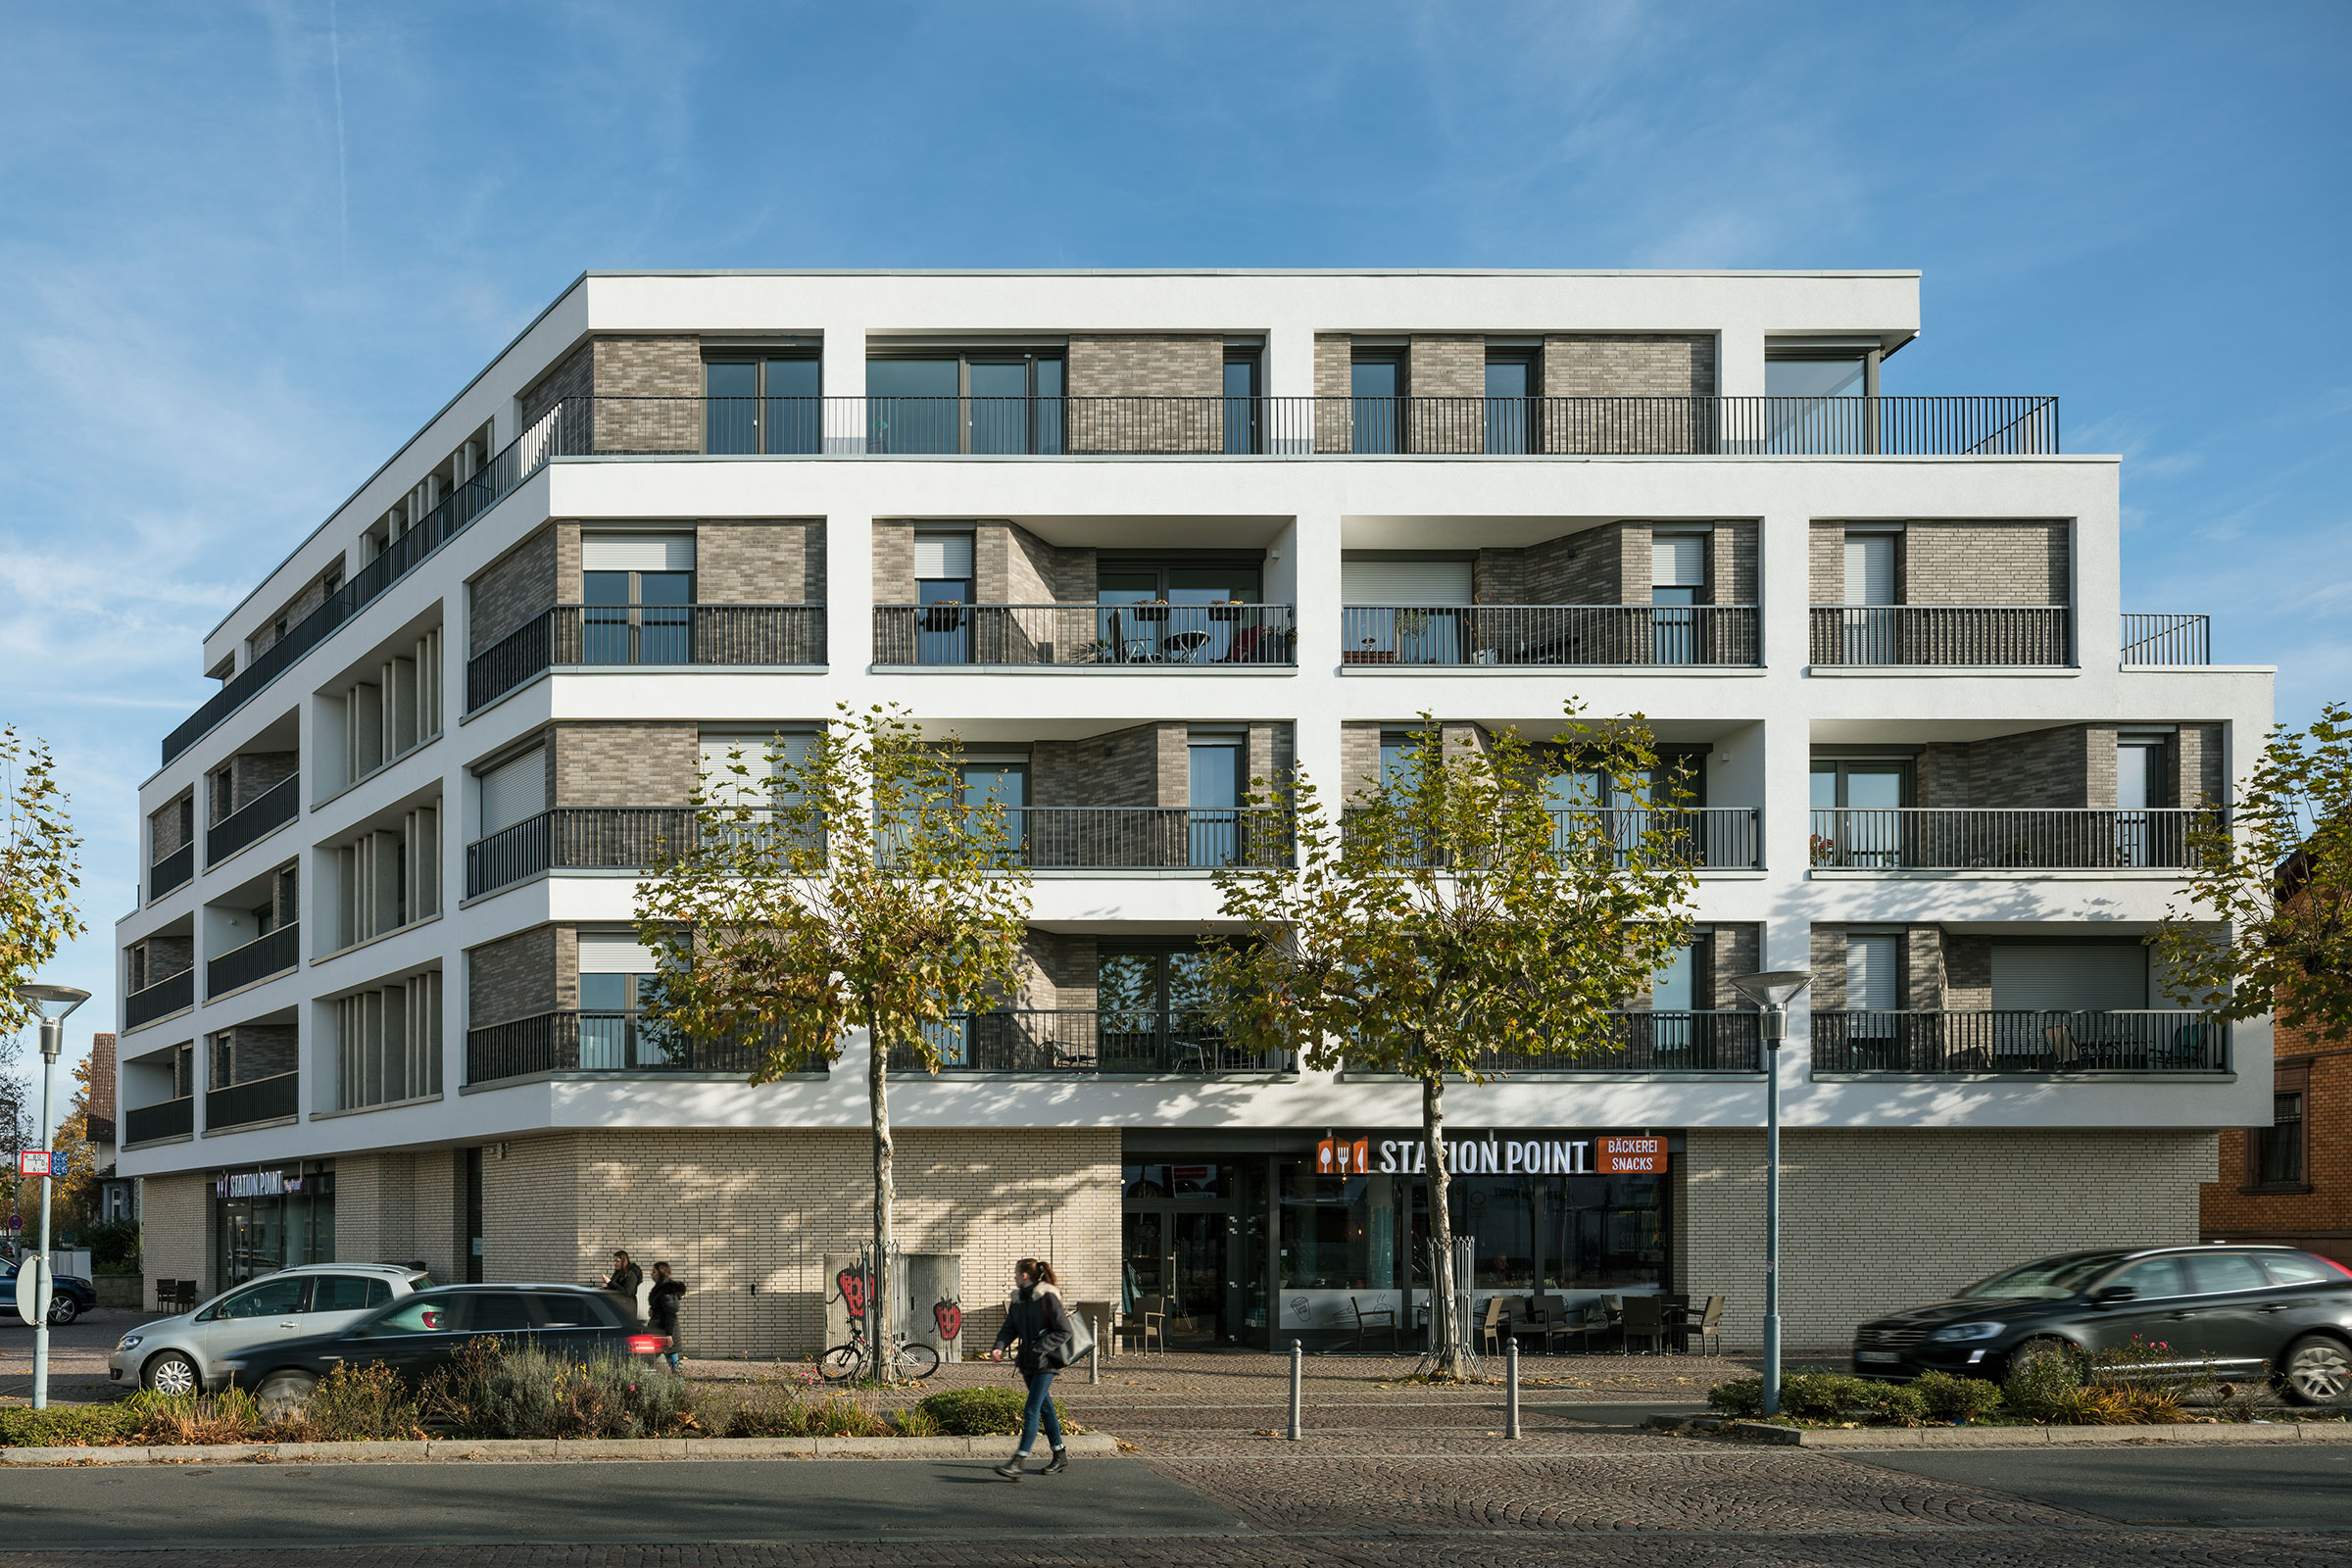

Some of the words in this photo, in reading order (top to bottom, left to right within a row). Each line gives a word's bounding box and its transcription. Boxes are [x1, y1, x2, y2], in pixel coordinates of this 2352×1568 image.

[1608, 1138, 1658, 1153] BÄCKEREI
[1380, 1140, 1497, 1174] STAION
[1506, 1141, 1589, 1174] POINT
[1611, 1156, 1653, 1171] SNACKS
[229, 1173, 259, 1198] STATION
[260, 1170, 282, 1196] POINT
